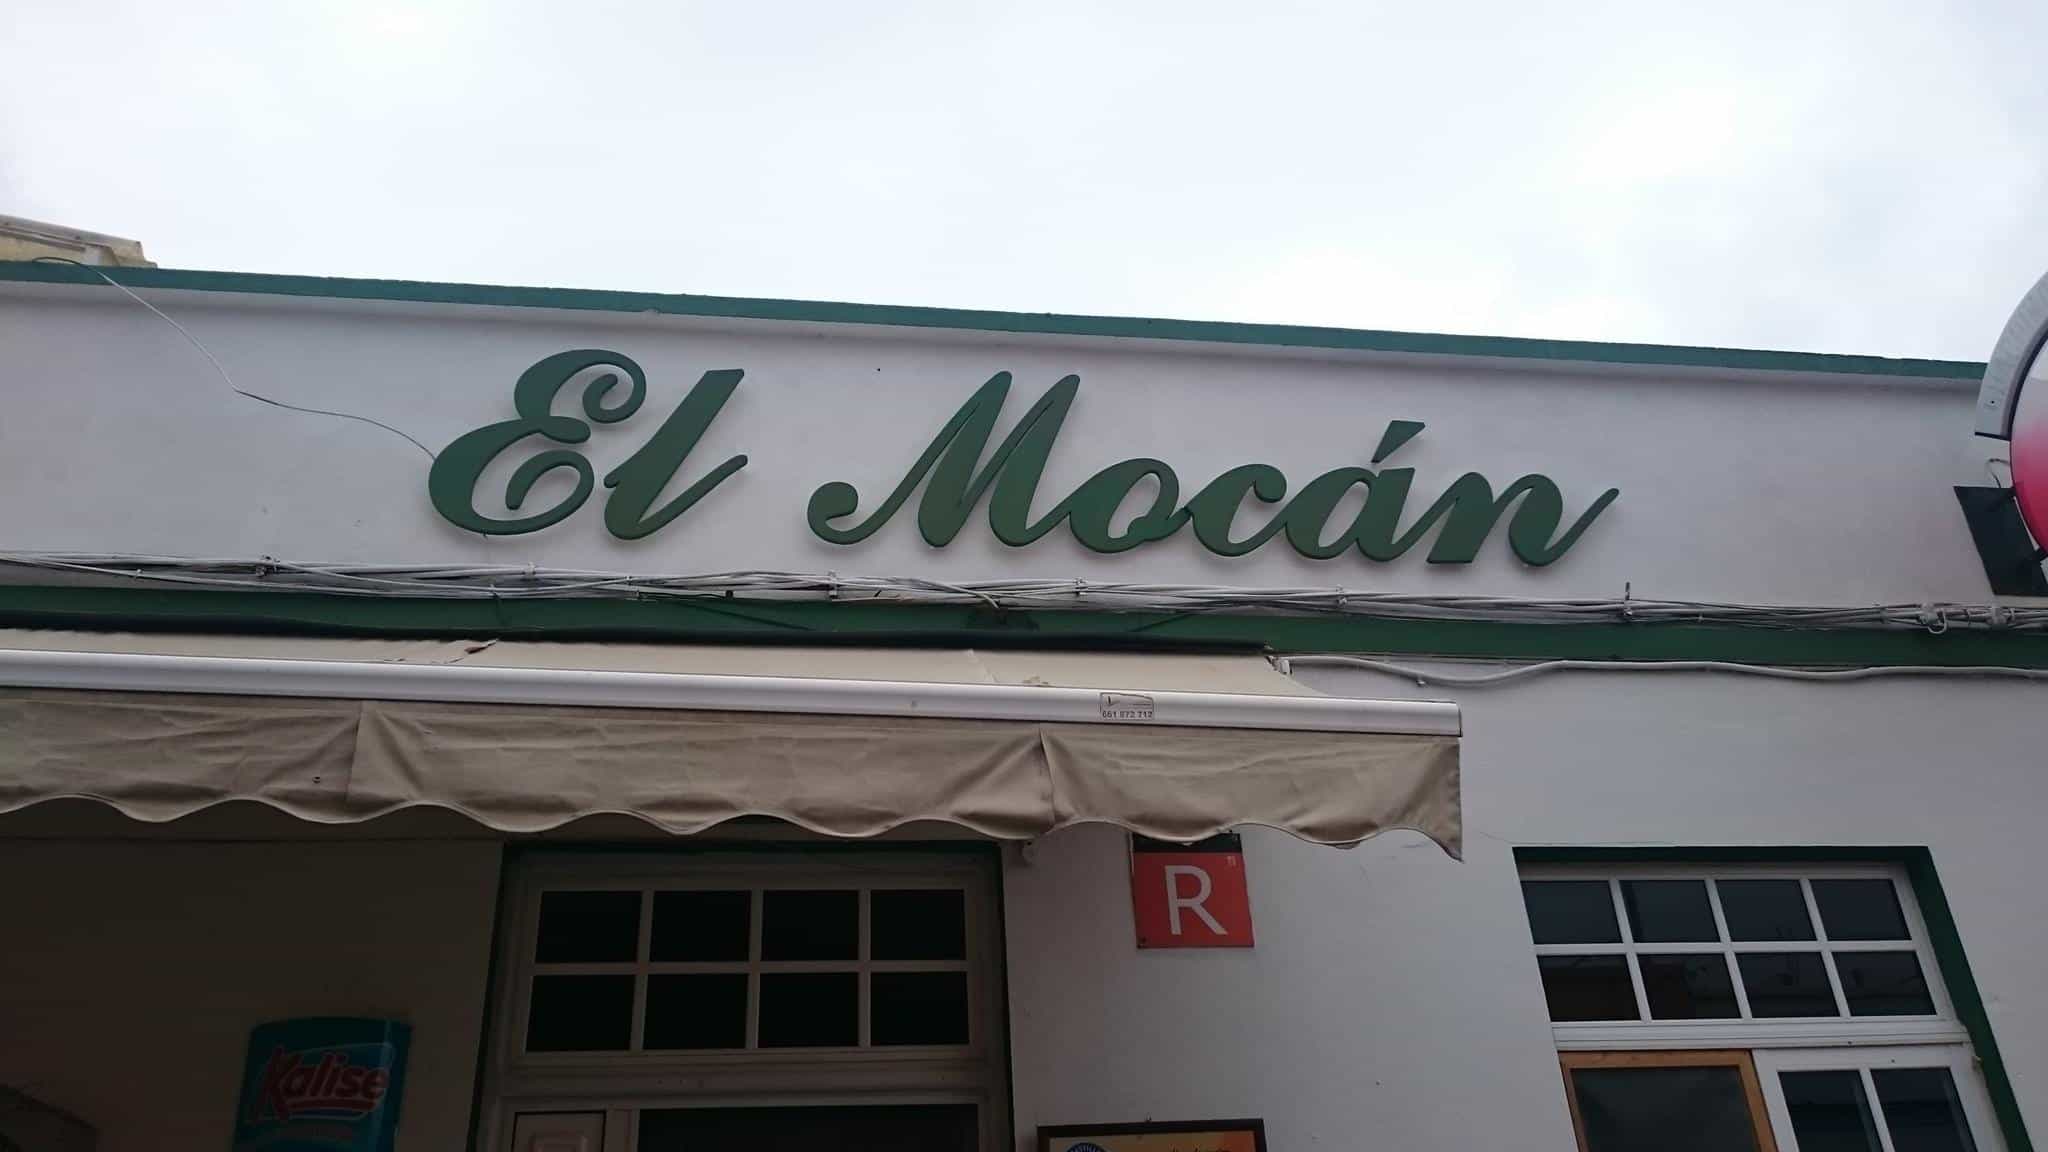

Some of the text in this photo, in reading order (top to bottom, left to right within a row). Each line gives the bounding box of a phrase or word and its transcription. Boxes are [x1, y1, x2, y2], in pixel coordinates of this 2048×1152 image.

[429, 349, 1620, 567] El Mocán
[1164, 864, 1228, 936] R
[254, 1044, 389, 1123] Kalise
